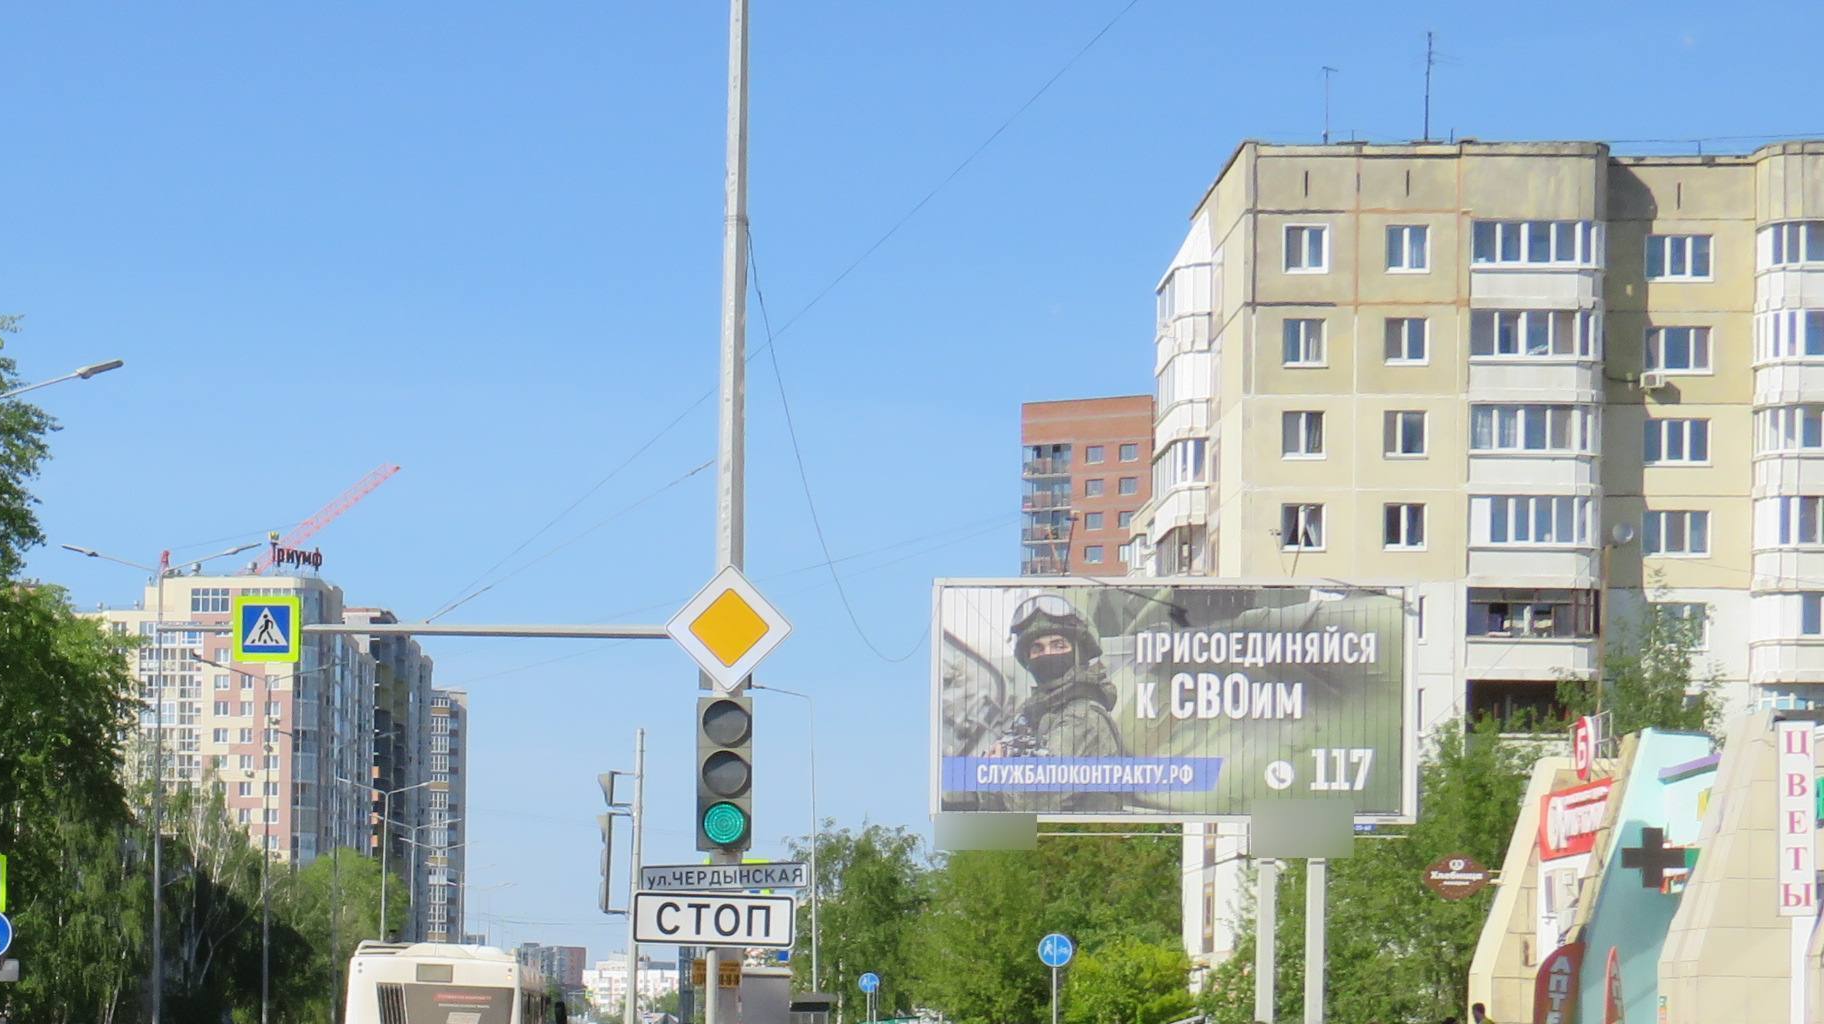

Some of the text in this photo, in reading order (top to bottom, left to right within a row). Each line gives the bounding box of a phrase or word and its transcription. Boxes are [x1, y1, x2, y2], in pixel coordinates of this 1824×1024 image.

[270, 542, 323, 571] Триумф
[1136, 626, 1376, 667] ПРИСОЕДИНЯЙСЯ
[976, 763, 1194, 786] СЛУЖБАПОКОНТРАКТУ.РФ
[1310, 748, 1374, 791] 117
[1781, 730, 1813, 908] ЦВЕТЫ
[656, 901, 771, 937] СТОП
